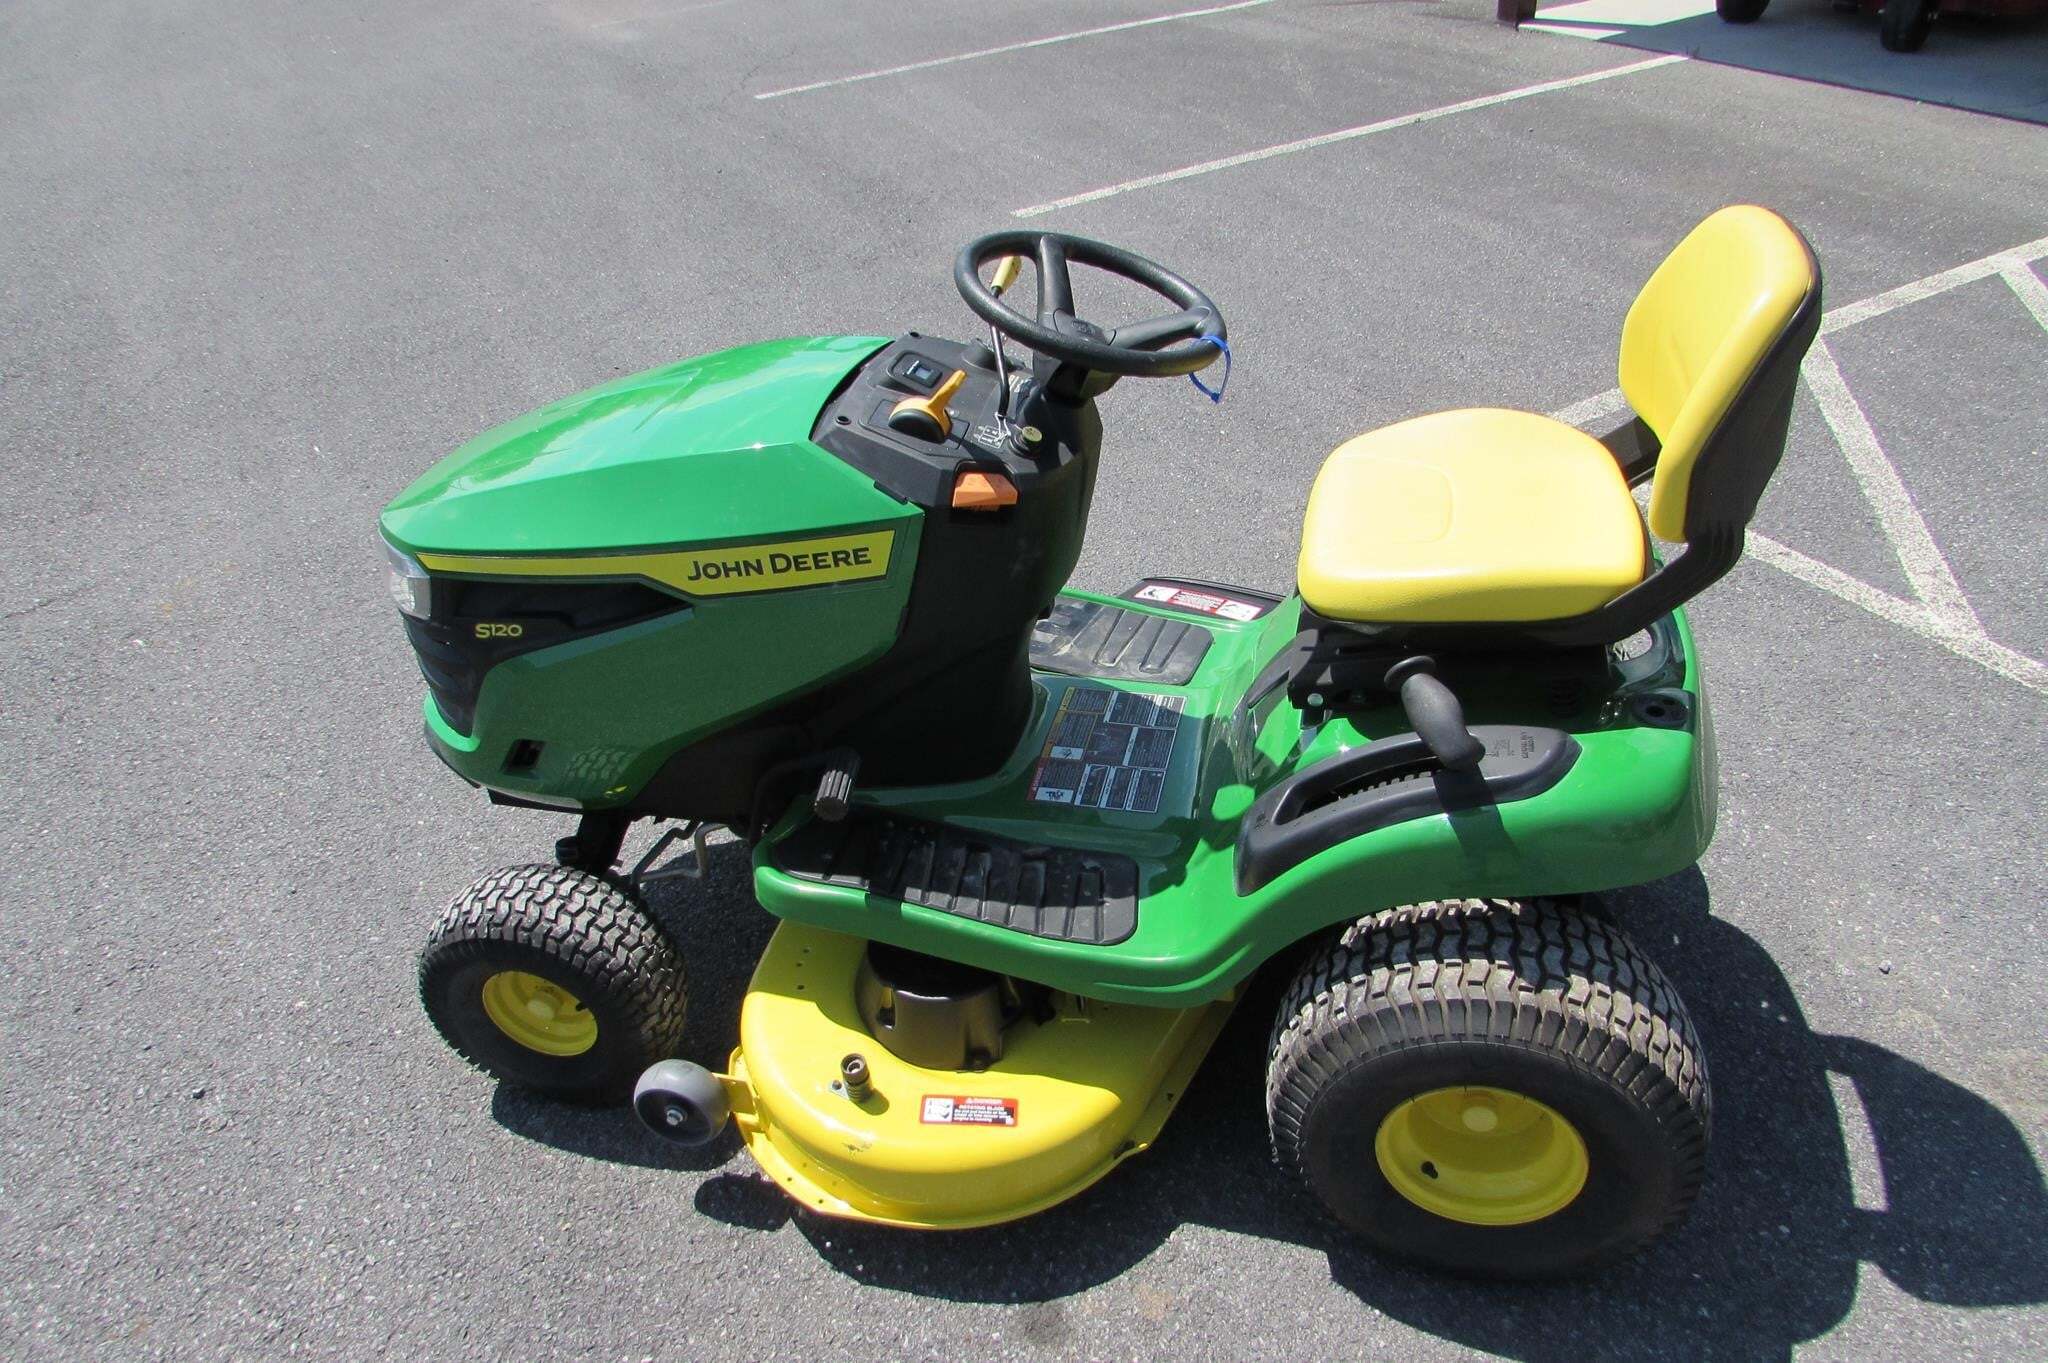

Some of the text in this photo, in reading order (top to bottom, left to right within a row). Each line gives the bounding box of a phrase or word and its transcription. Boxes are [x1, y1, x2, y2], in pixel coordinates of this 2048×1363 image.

[687, 547, 872, 581] JOHN DEERE
[475, 623, 523, 639] S120
